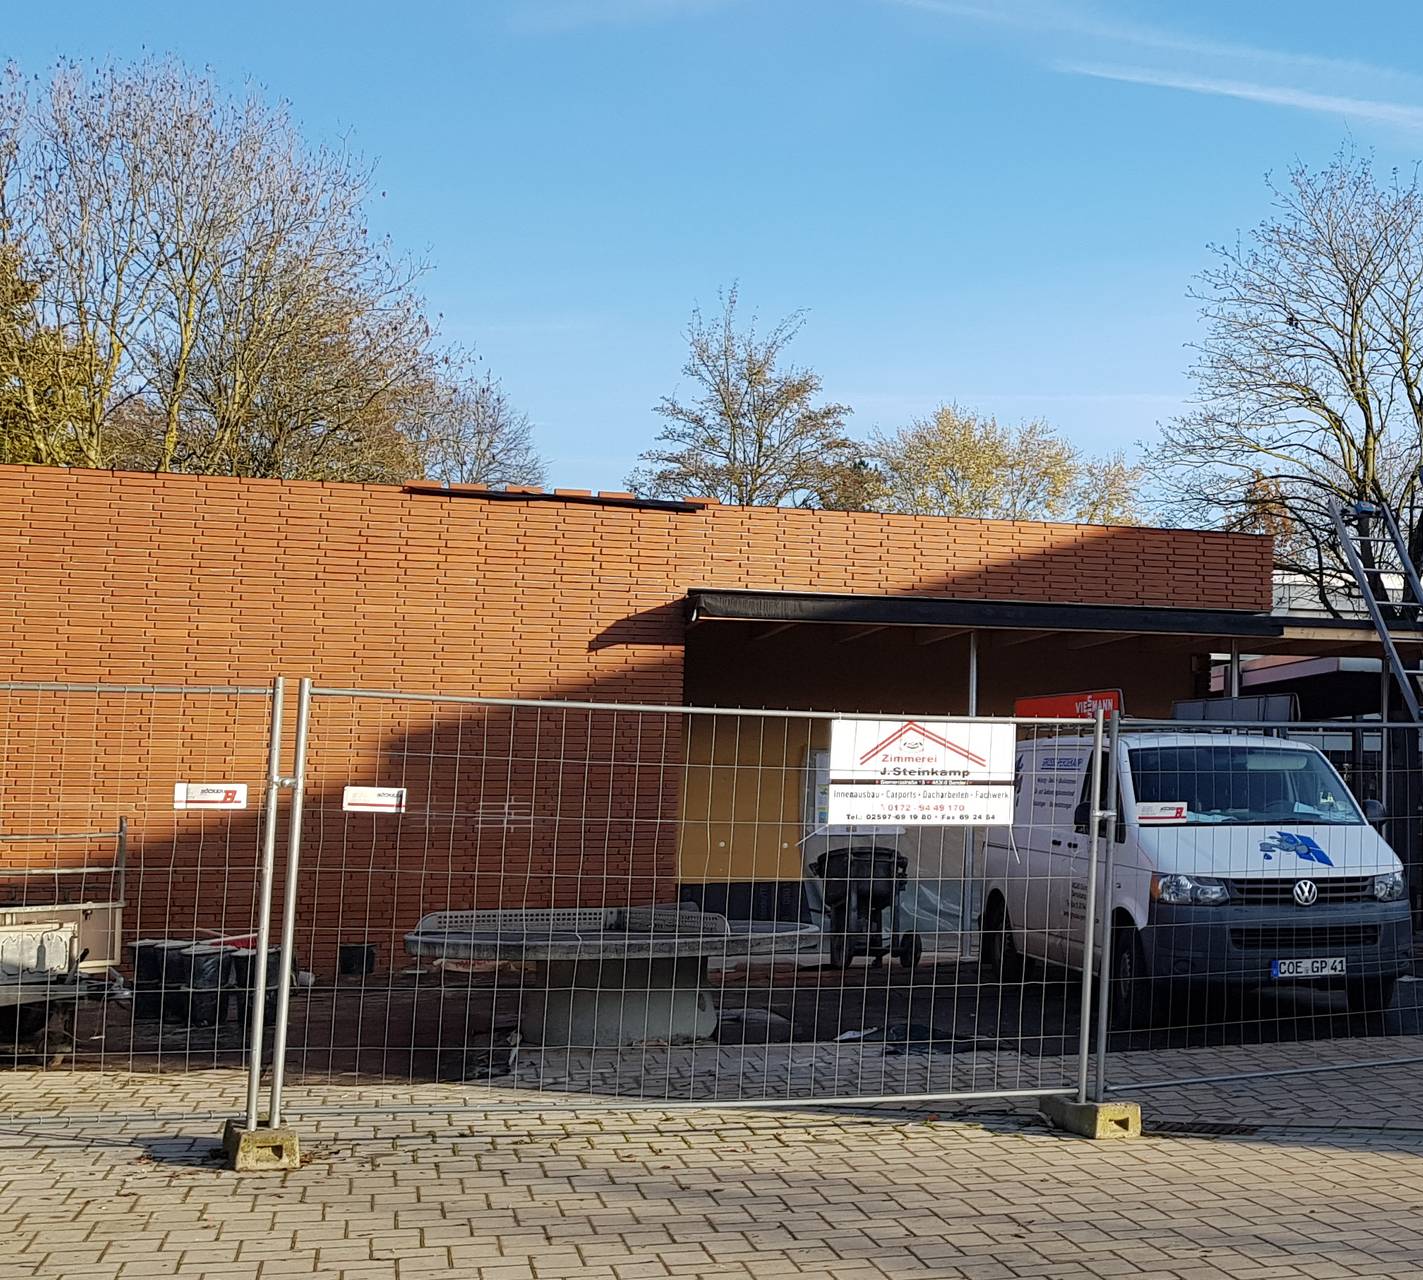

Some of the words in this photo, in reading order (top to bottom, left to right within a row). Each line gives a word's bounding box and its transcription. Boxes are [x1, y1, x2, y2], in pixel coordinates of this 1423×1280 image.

[881, 753, 937, 763] Zimmerei
[833, 789, 880, 799] Innenausbau
[885, 789, 917, 800] Carports
[922, 790, 969, 799] Dacharbeiten
[975, 790, 1009, 799] Fachwerk
[1278, 961, 1304, 975] COE
[1311, 960, 1328, 974] GP
[1330, 959, 1345, 973] 41
